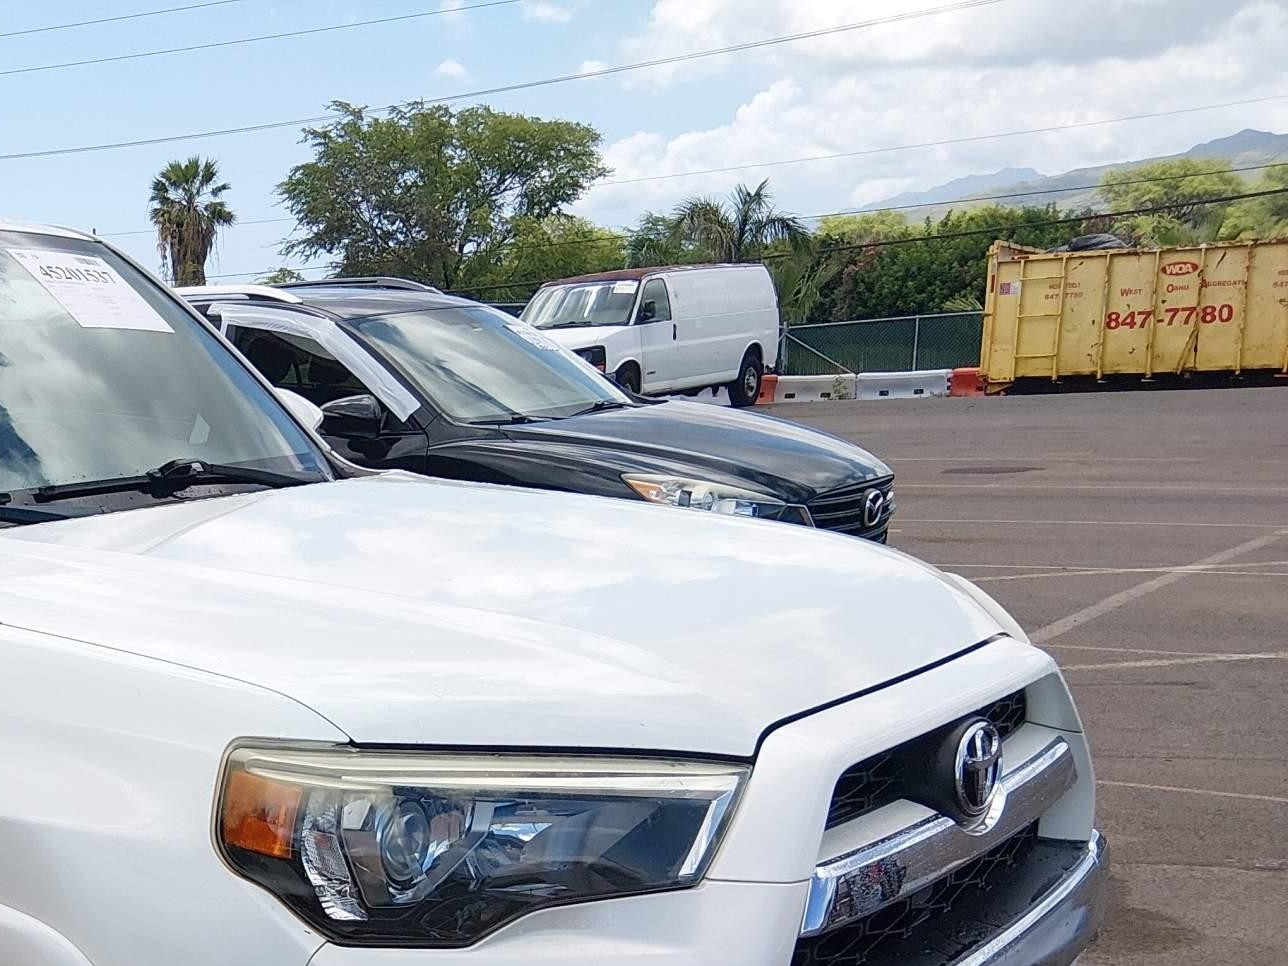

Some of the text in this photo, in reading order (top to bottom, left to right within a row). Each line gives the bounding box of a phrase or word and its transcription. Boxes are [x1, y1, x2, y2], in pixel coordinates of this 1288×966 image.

[39, 265, 116, 284] 45201537
[1165, 263, 1193, 275] WOA
[1105, 303, 1234, 330] 847-7780
